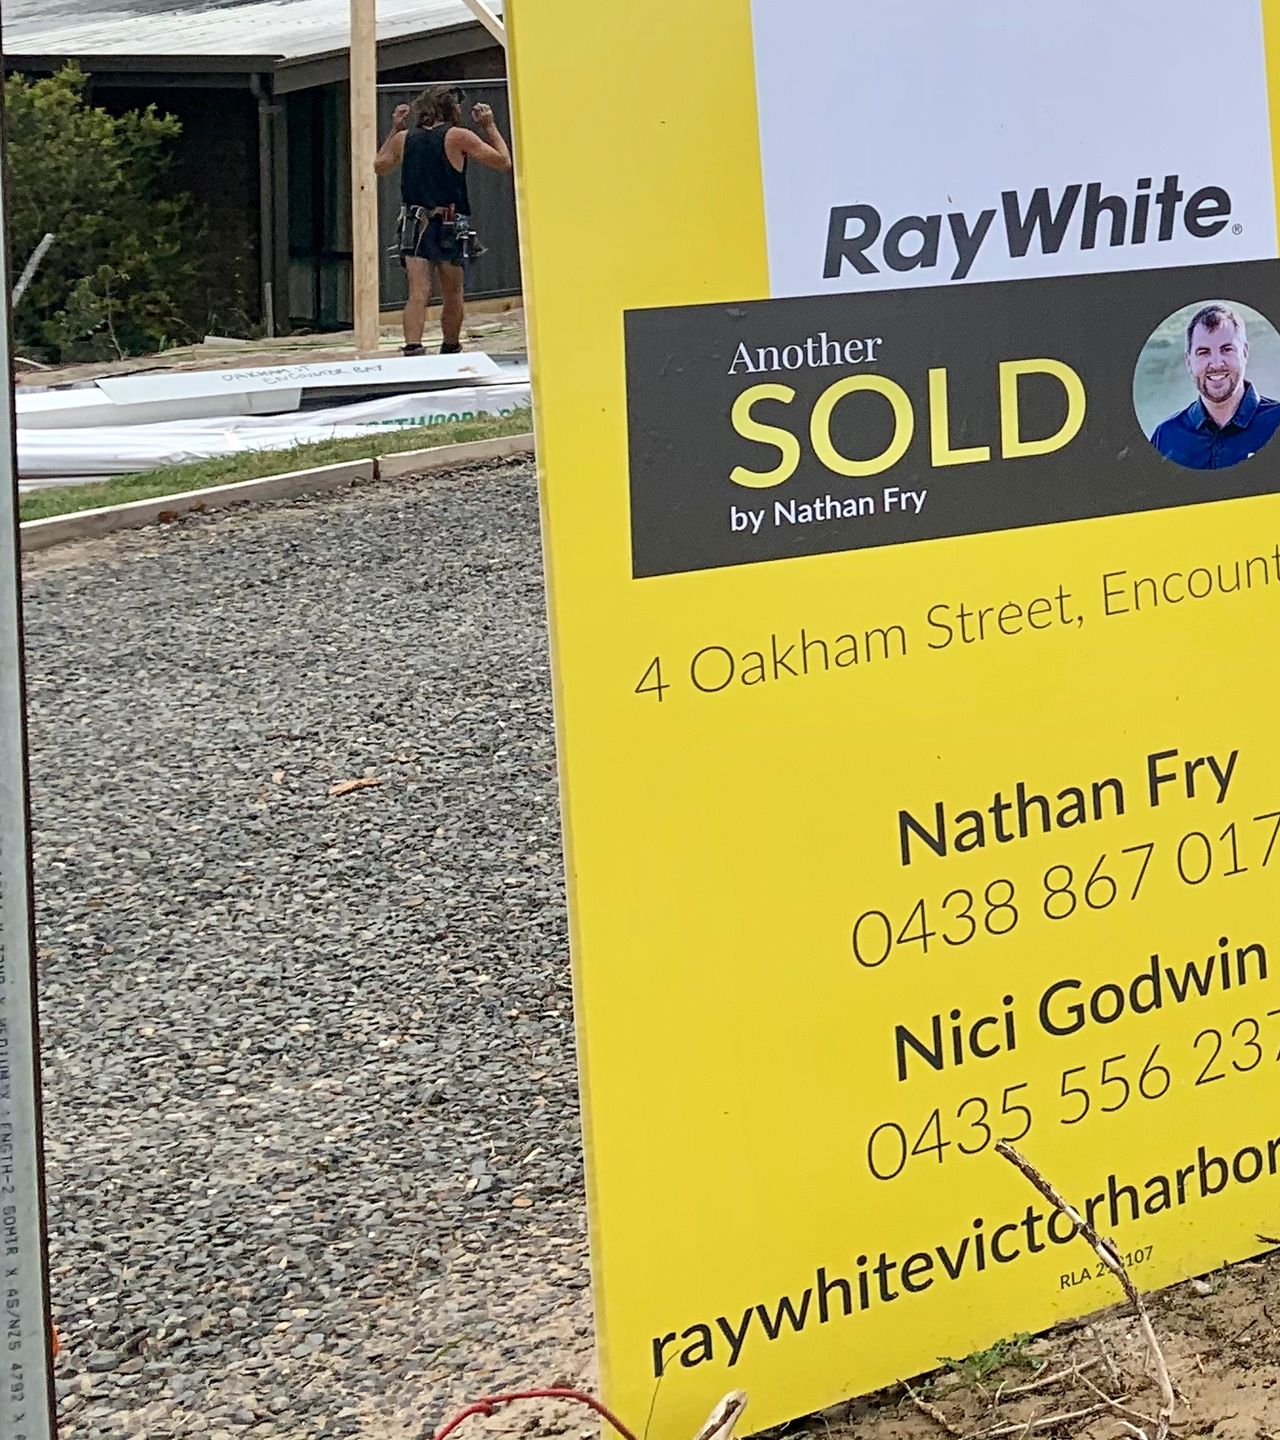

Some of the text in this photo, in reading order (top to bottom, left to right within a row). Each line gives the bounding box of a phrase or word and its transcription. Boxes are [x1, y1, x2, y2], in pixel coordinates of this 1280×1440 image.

[727, 331, 883, 375] Another
[728, 357, 1086, 490] SOLD
[730, 486, 928, 534] by Nathan Fry
[634, 656, 671, 703] 4
[690, 619, 907, 693] Oakham
[926, 584, 1084, 650] Street,
[898, 748, 1240, 867] Nathan Fry
[852, 878, 1019, 968] 0438
[1043, 841, 1155, 920] 867
[894, 936, 1268, 1082] Nici Godwin
[867, 1083, 1032, 1181] 0435
[1060, 1044, 1171, 1125] 556
[1060, 1245, 1154, 1290] RLA 2107
